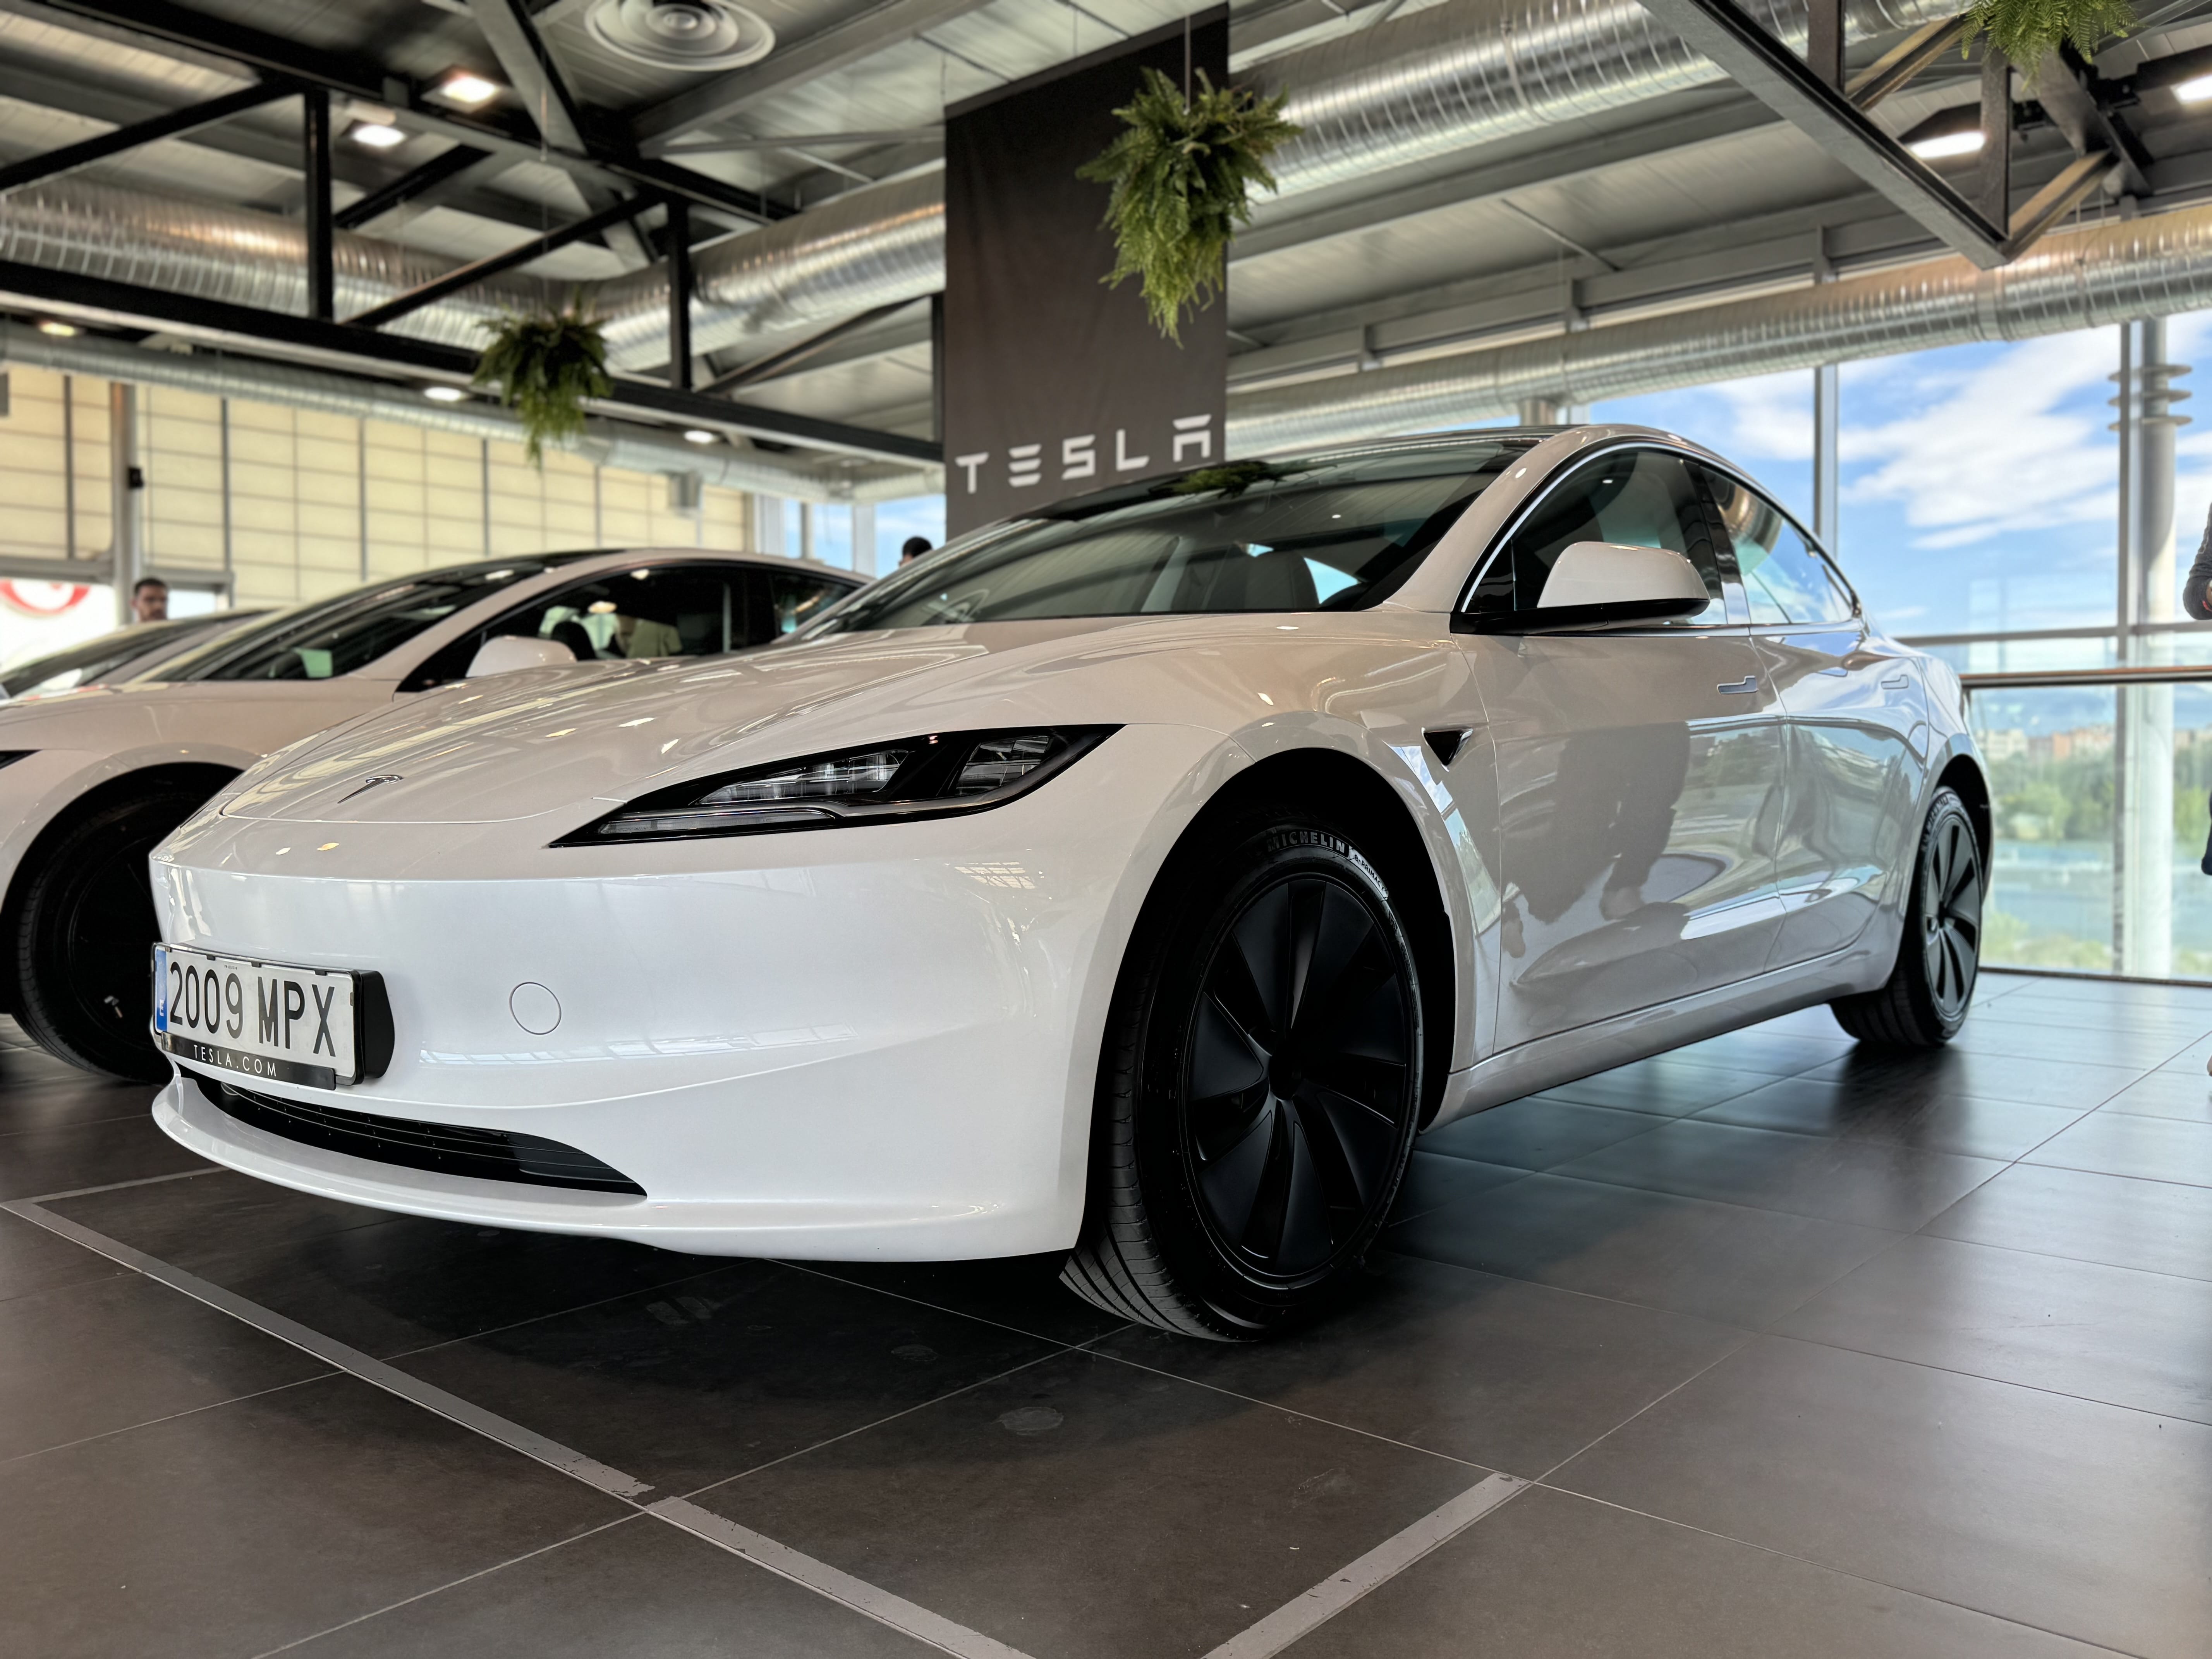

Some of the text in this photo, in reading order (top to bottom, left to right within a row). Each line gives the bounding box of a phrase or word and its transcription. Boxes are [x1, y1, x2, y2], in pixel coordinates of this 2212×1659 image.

[955, 413, 1212, 494] TESLA
[1266, 830, 1346, 854] MICHELIN
[169, 961, 336, 1057] 2009 MPX
[194, 1044, 276, 1077] TESLA.COM
